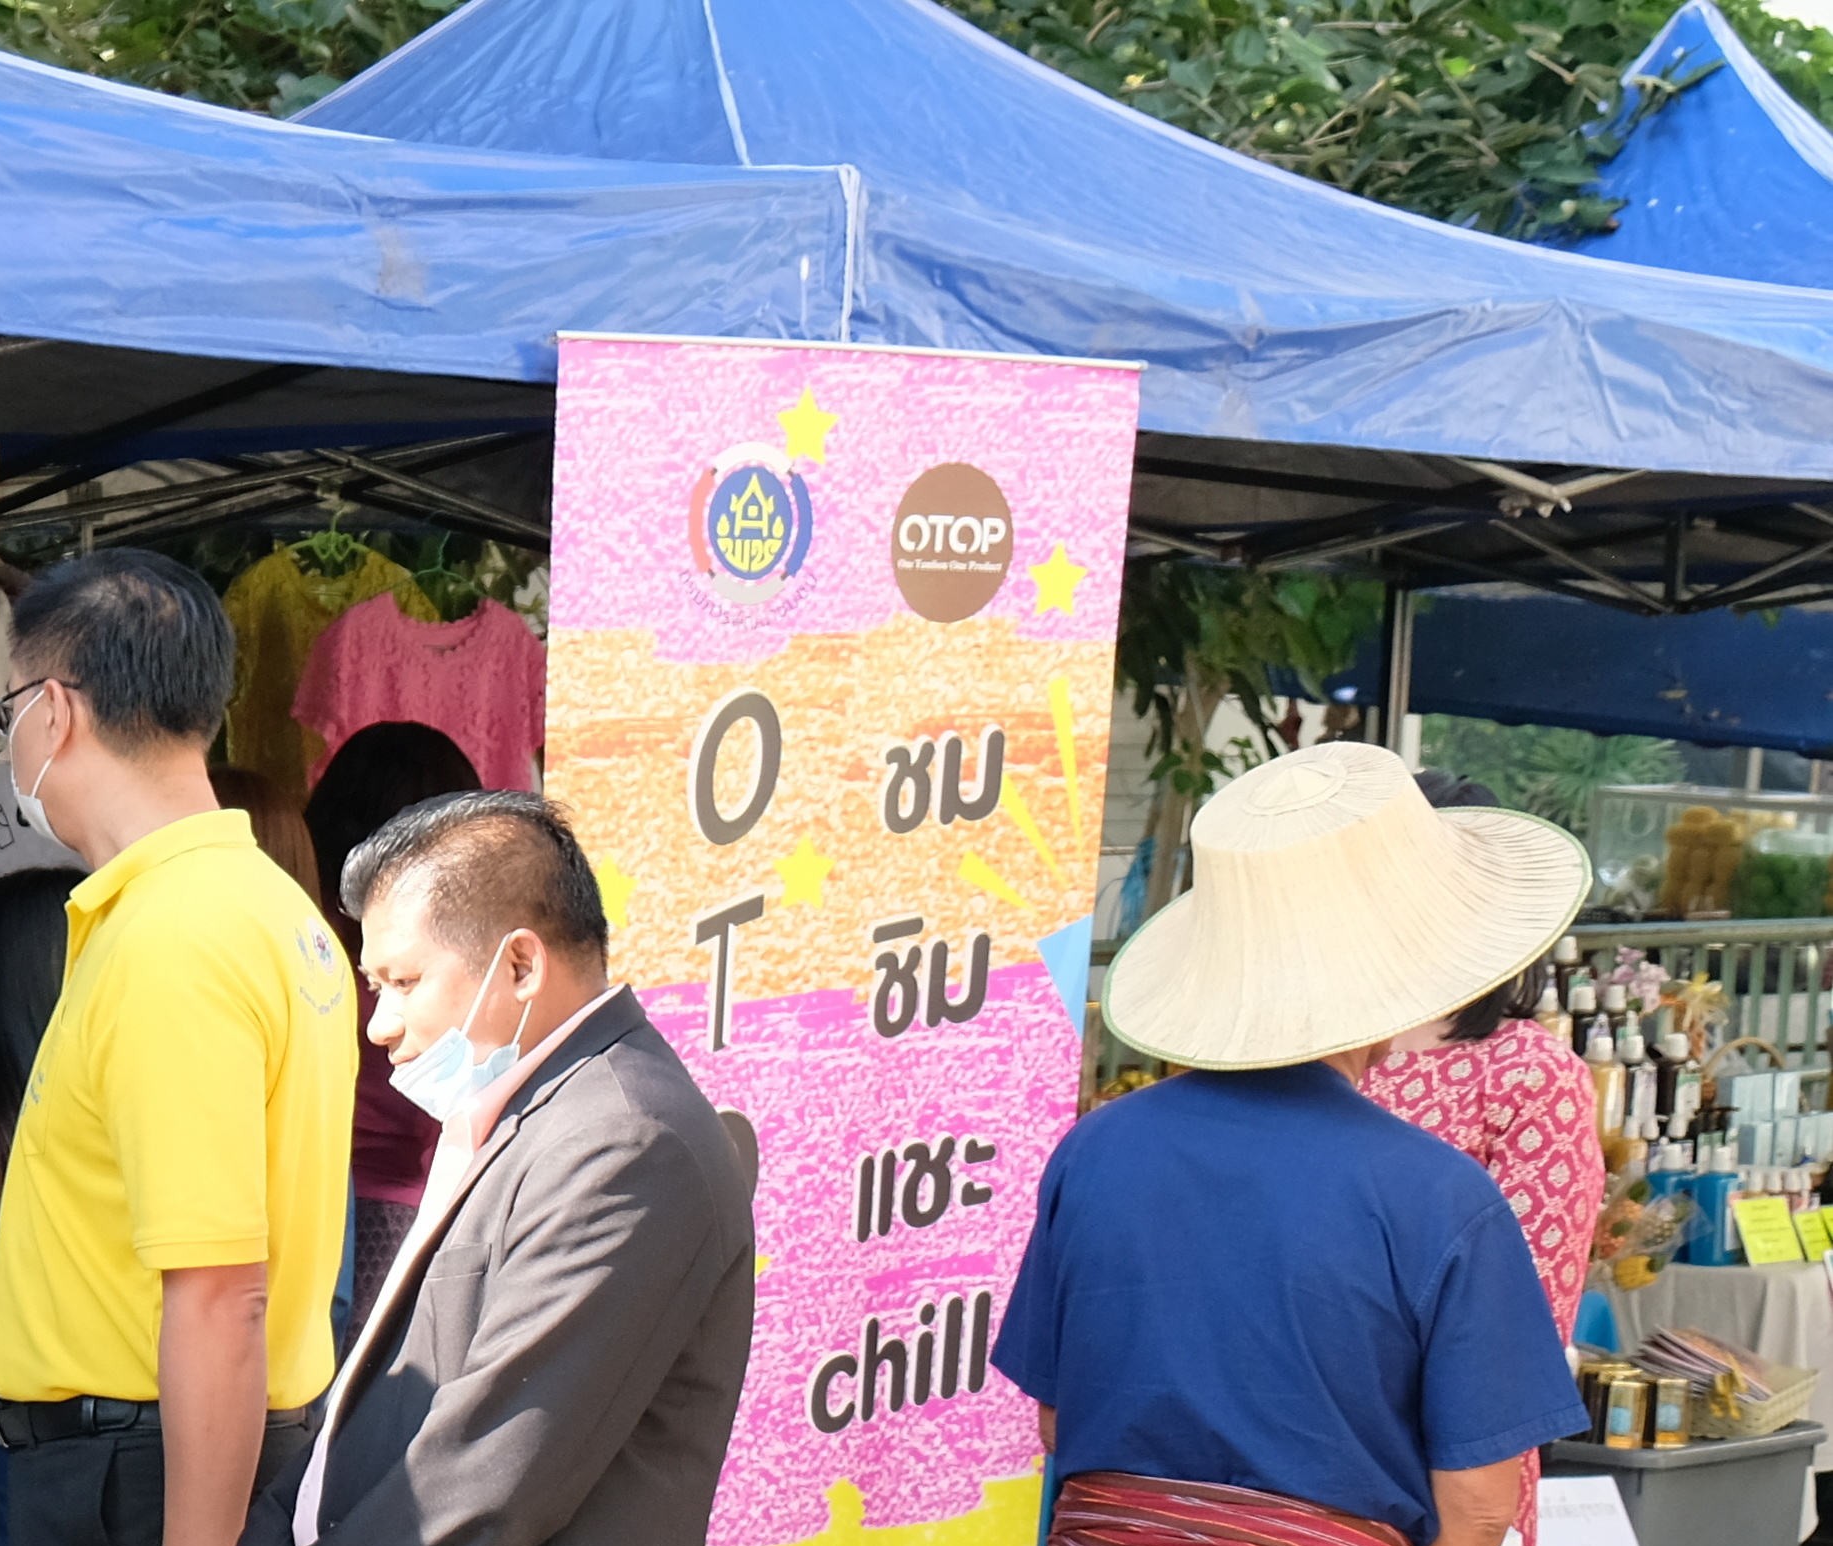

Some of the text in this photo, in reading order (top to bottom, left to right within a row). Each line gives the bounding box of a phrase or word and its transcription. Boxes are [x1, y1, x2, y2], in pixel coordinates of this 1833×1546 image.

[898, 513, 1007, 554] OTOP
[884, 727, 1004, 834] ชม
[873, 917, 990, 1037] ชิม
[857, 1136, 996, 1243] แชะ
[809, 1291, 992, 1434] chill
